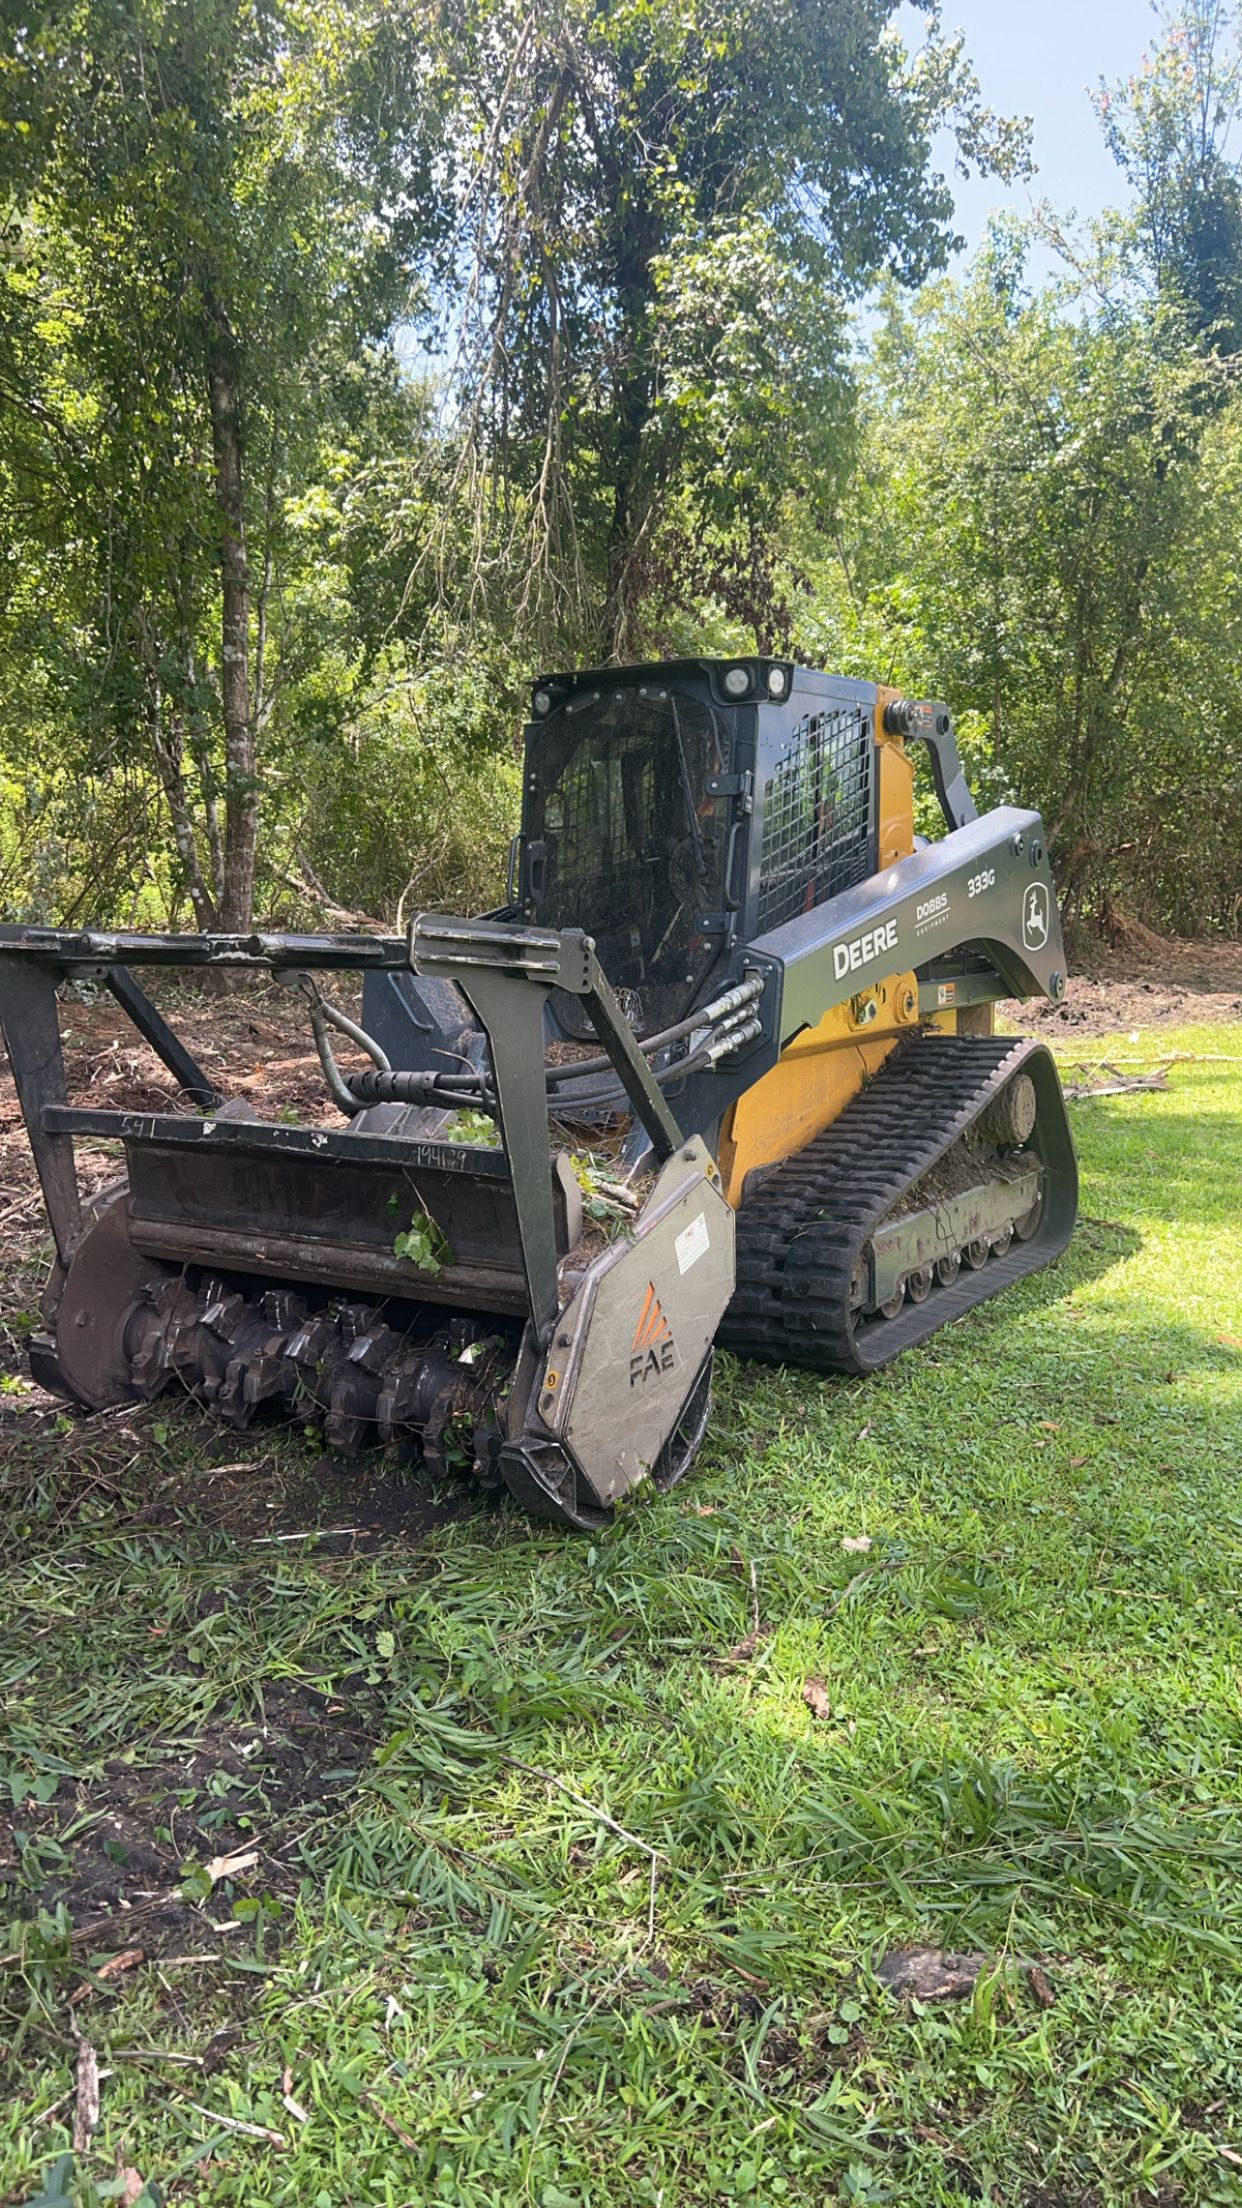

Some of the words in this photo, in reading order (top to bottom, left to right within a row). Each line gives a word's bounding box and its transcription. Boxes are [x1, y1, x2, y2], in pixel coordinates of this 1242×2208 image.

[967, 868, 996, 898] 333G
[916, 892, 948, 920] DOBBS
[832, 918, 898, 980] DEERE
[629, 1340, 675, 1389] FAE
